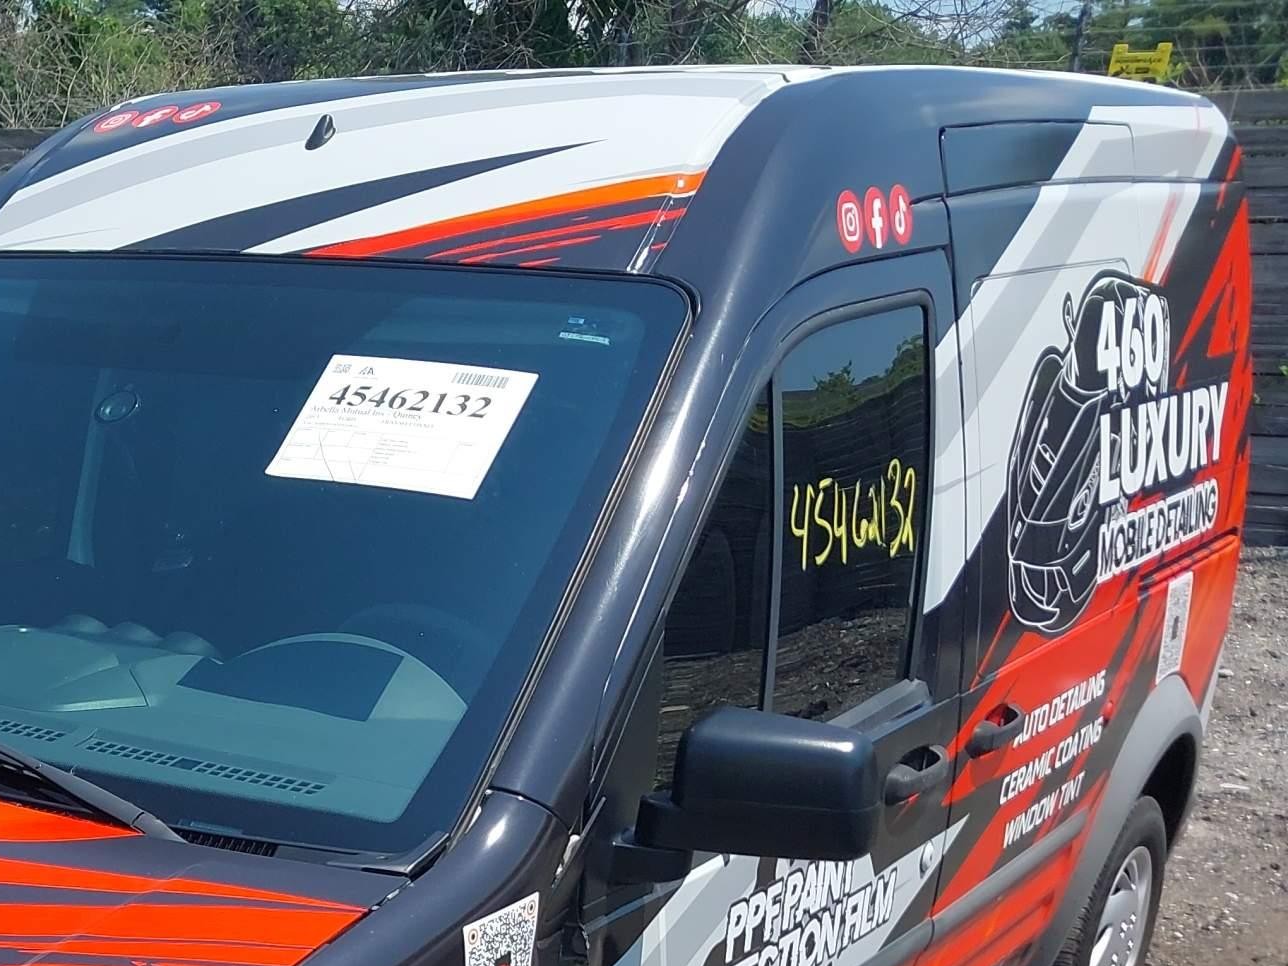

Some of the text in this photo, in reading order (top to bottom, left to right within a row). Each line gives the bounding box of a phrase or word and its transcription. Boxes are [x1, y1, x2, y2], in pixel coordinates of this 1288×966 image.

[1097, 294, 1166, 392] 460
[328, 383, 493, 419] 45462132
[1098, 381, 1230, 505] LUXURY
[1099, 484, 1217, 577] MOBILE DETAILING
[1049, 669, 1106, 726] DETAILING
[1000, 716, 1105, 805] CERAMIC COATING
[1003, 769, 1086, 849] WINDOW TINT
[725, 860, 855, 964] PPF PAINT
[842, 867, 898, 949] FILM
